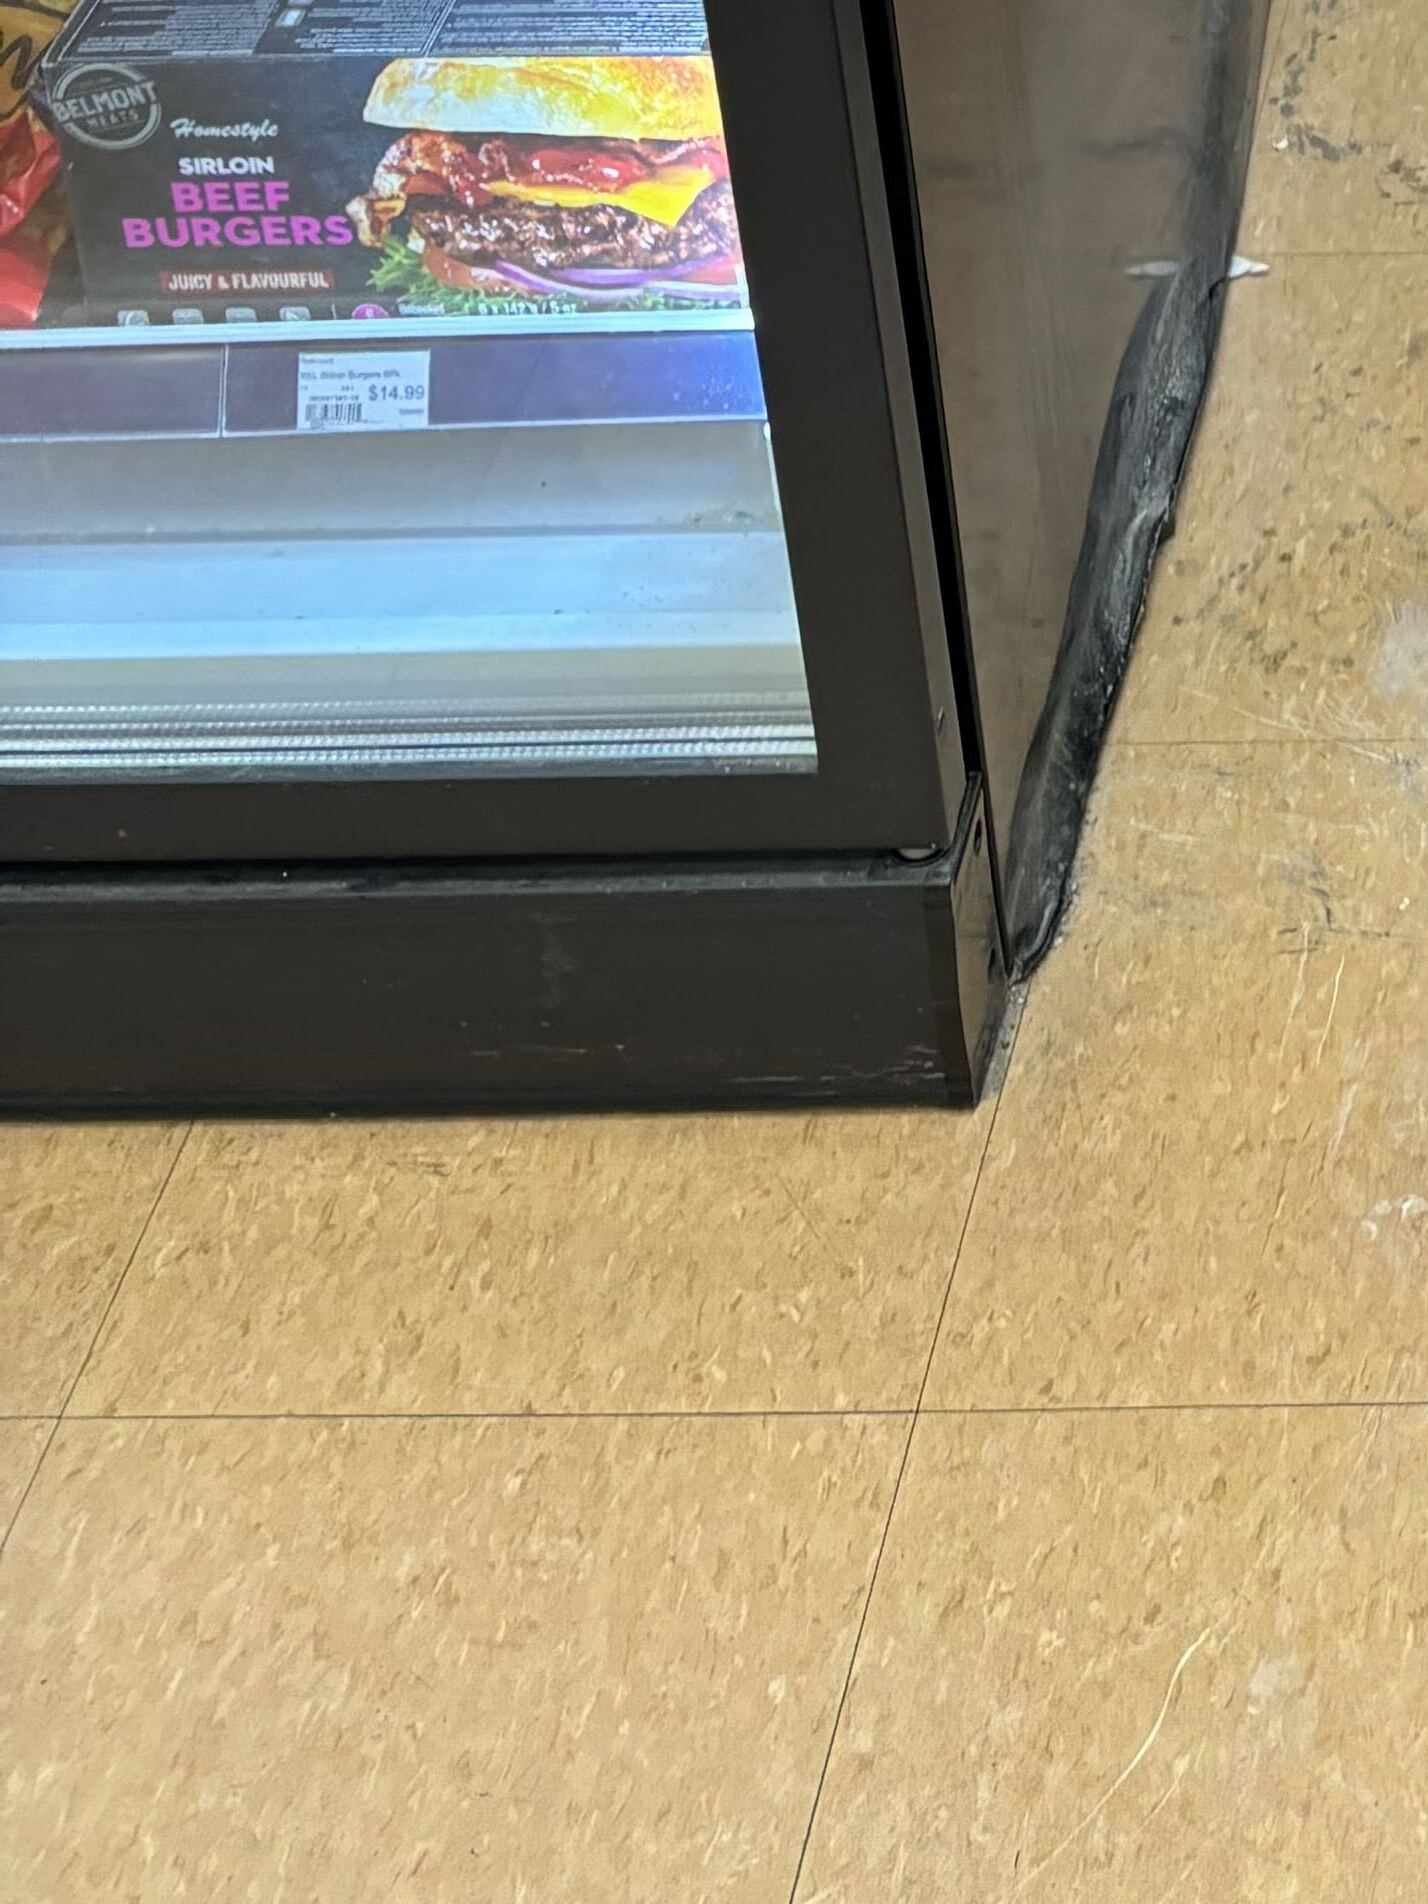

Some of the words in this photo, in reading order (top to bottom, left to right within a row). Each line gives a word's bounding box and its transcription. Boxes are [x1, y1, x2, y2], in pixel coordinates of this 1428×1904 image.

[53, 80, 157, 122] BELMONT
[170, 118, 278, 140] Homestyle
[178, 156, 275, 176] SIRLOIN
[170, 181, 290, 213] BEEF
[121, 215, 353, 248] BURGERS
[168, 273, 212, 290] JUICY
[232, 271, 330, 289] FLAVOURFUL
[368, 385, 425, 401] $14.99
